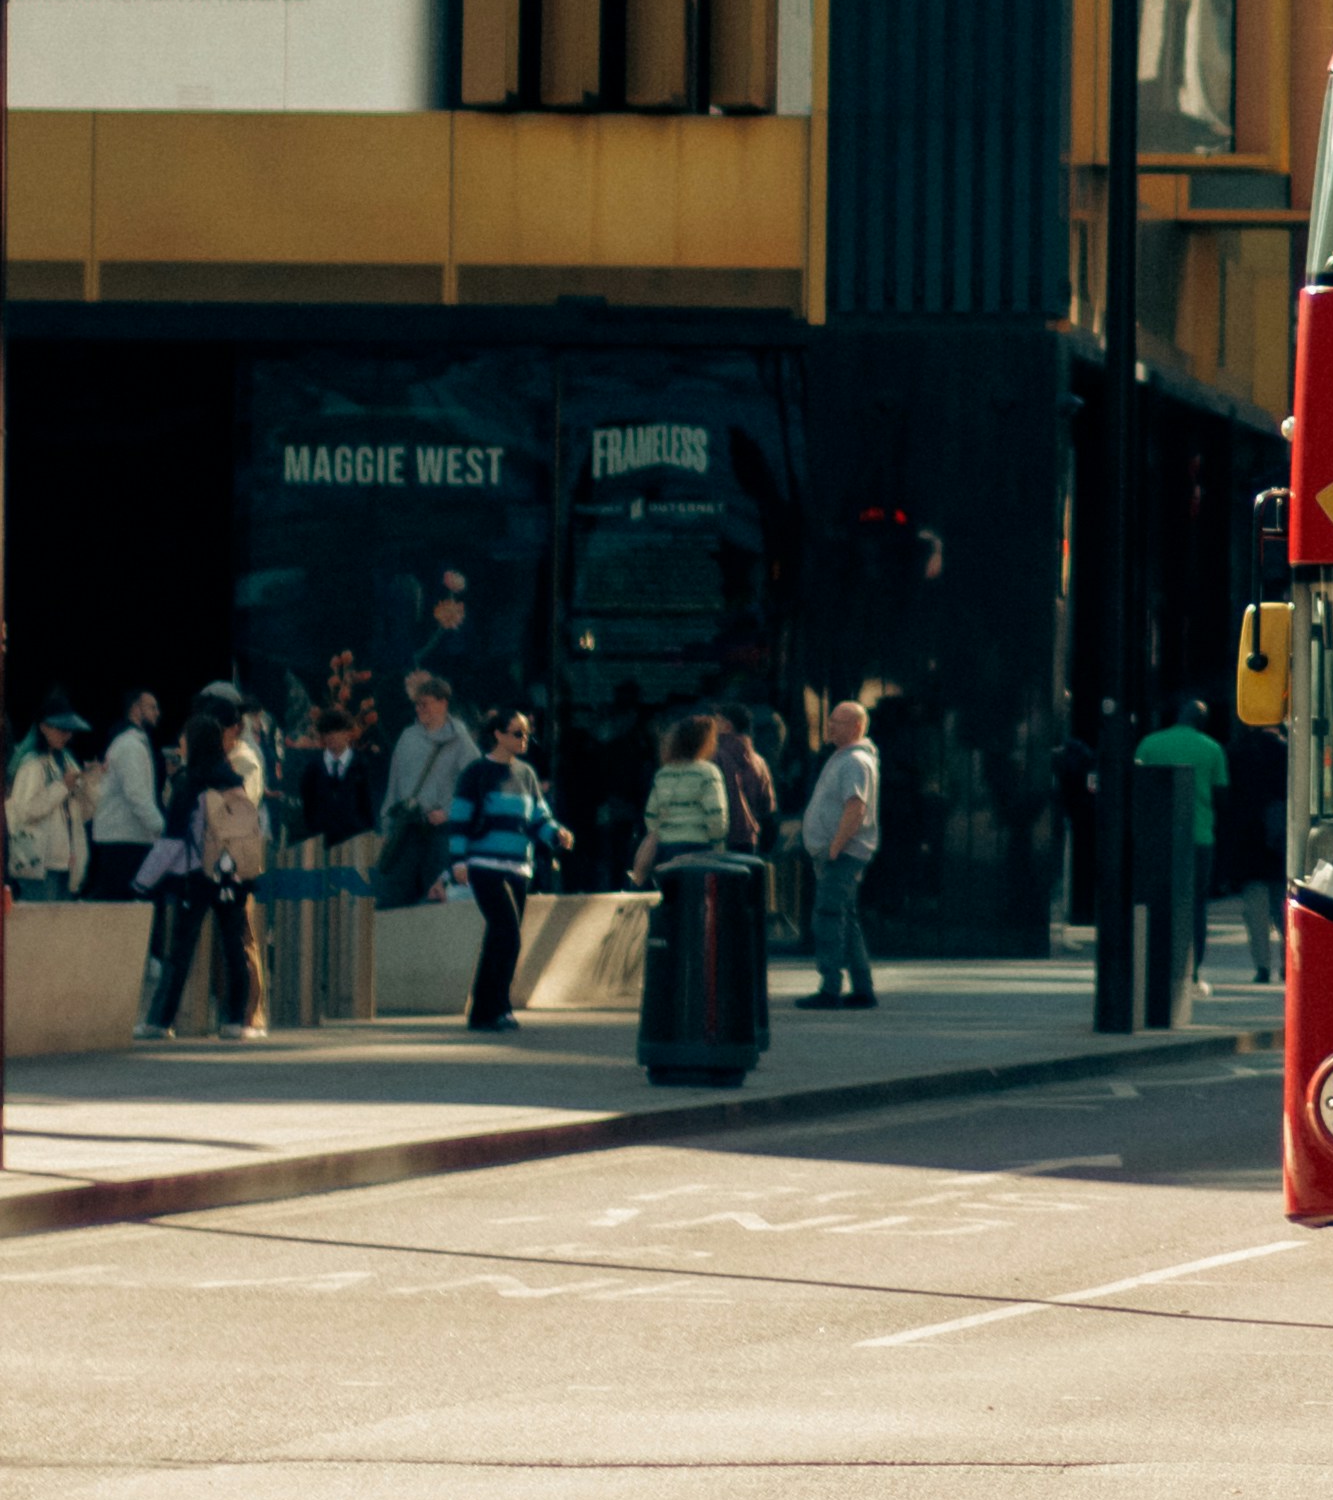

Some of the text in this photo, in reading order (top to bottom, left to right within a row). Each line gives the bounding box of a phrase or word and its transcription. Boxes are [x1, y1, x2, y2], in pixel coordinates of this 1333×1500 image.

[284, 445, 505, 486] MAGGIE WEST
[592, 424, 708, 477] FRAMELESS
